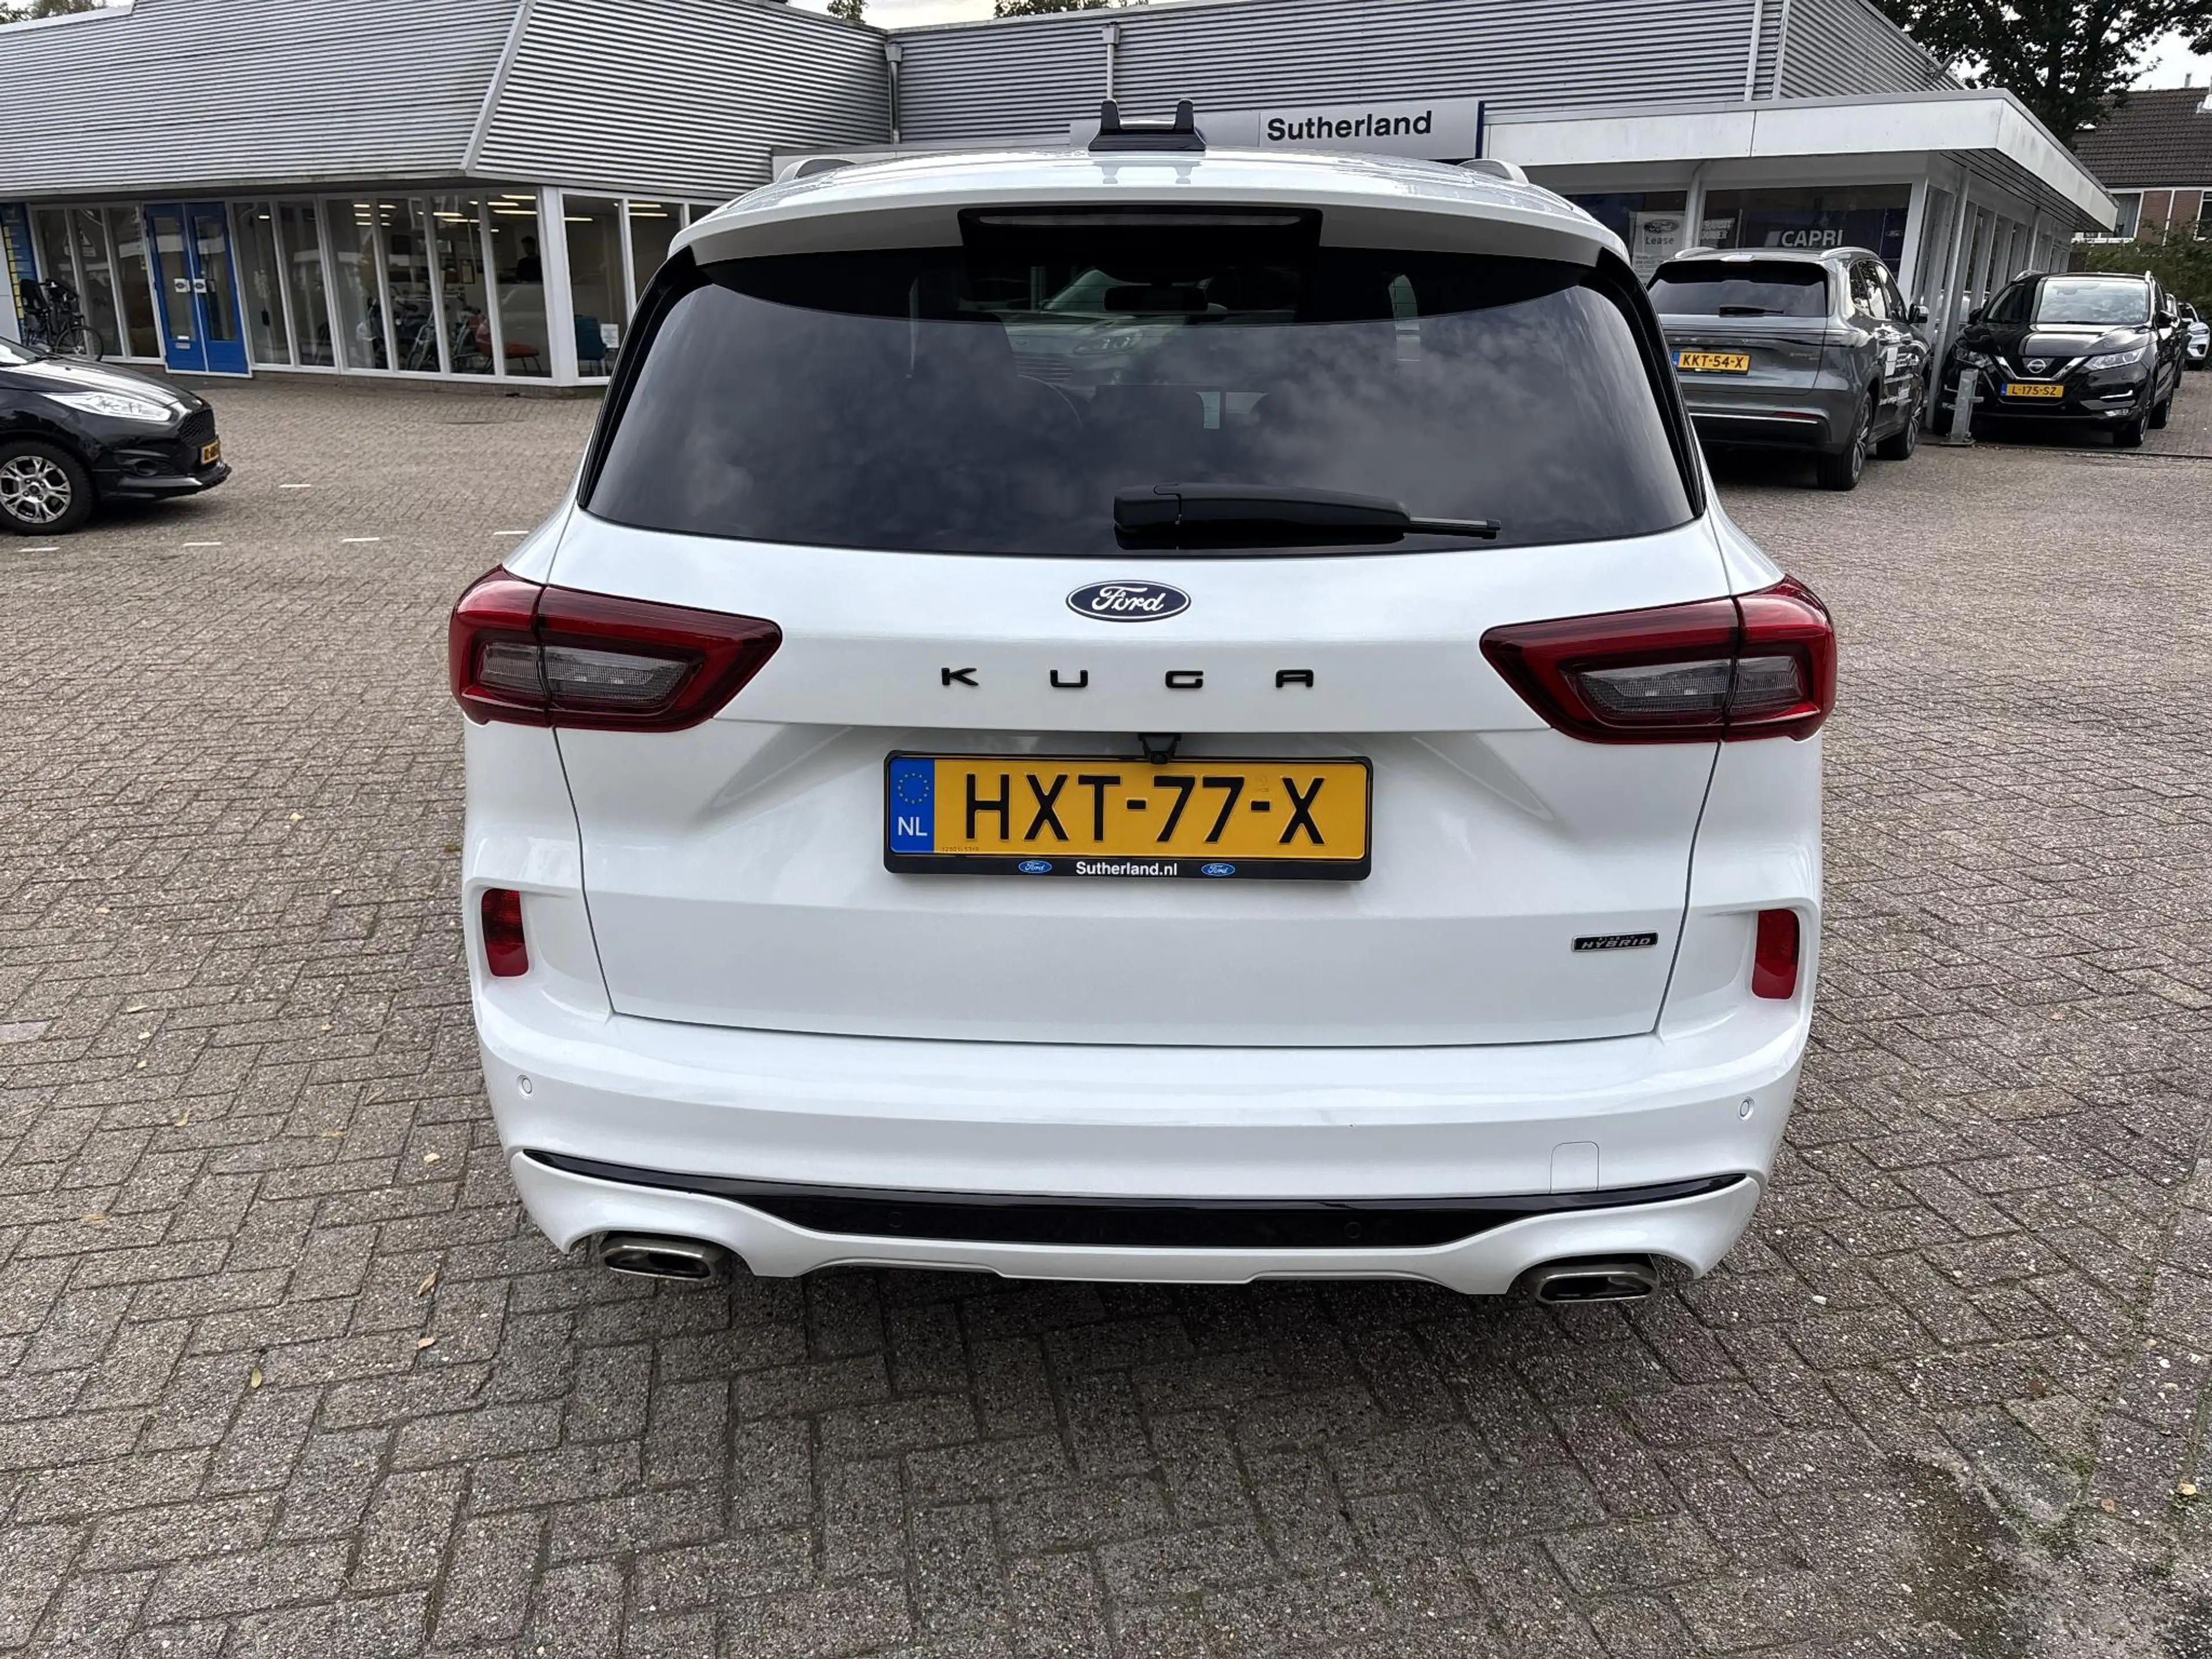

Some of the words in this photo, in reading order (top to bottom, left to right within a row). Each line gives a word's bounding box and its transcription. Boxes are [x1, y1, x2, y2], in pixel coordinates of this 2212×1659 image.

[1267, 110, 1432, 141] Sutherland
[1646, 236, 1674, 245] Lease
[1781, 230, 1843, 247] CAPRI
[1683, 354, 1744, 369] KKT-54-X
[2012, 386, 2057, 396] L-175-SZ
[1092, 586, 1166, 611] Ford
[941, 667, 1314, 689] KUGA
[965, 773, 1325, 845] HXT-77-X
[898, 816, 928, 836] NL
[1075, 862, 1177, 876] Sutherland.nl
[1582, 938, 1651, 949] HYBRID
